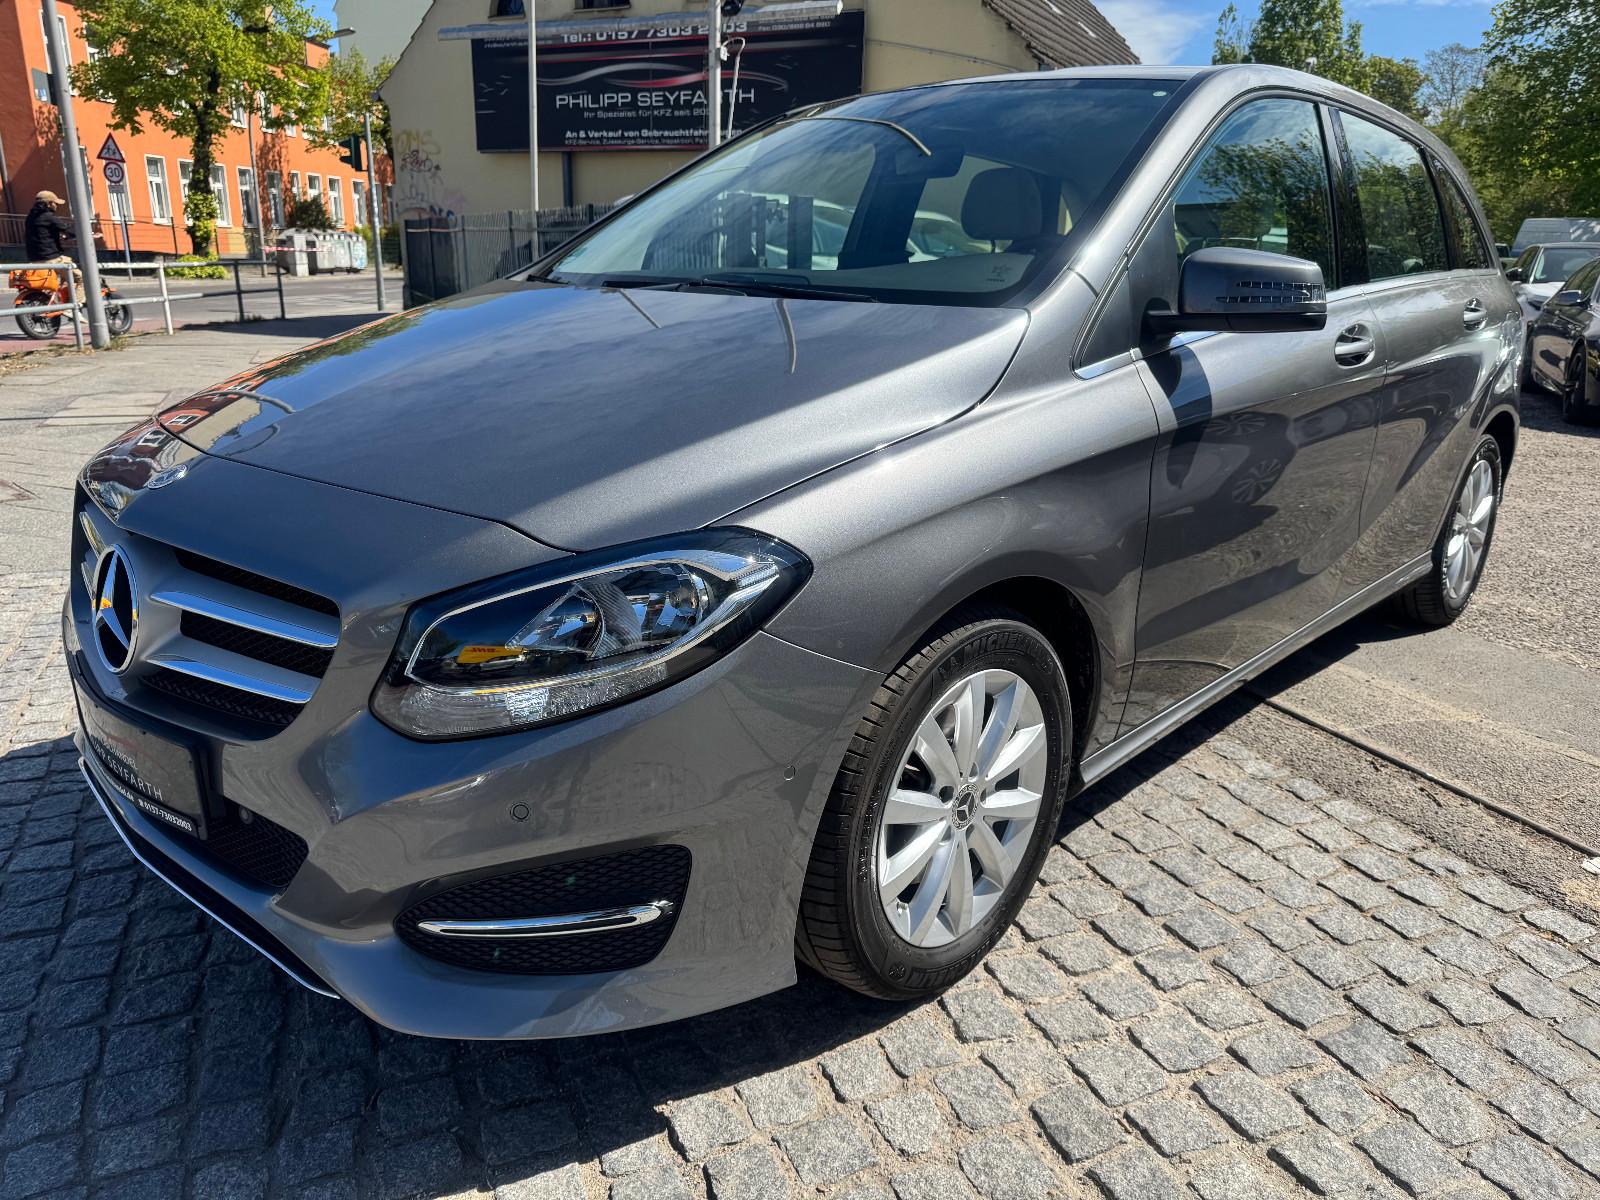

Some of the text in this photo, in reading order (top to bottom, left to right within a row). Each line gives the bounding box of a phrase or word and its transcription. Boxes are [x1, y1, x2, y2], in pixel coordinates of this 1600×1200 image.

[561, 33, 592, 43] Tel.:
[697, 21, 748, 34] 203
[555, 88, 755, 109] PHILIPP SEYFATH
[584, 110, 596, 118] Ihr
[597, 110, 637, 119] Spezialist
[638, 109, 651, 118] für
[653, 109, 673, 117] KFZ
[673, 109, 691, 117] seit
[565, 130, 578, 138] An
[579, 130, 586, 138] &
[587, 130, 622, 138] Verkauf
[107, 167, 120, 178] 30
[107, 755, 163, 801] SEYFARTH
